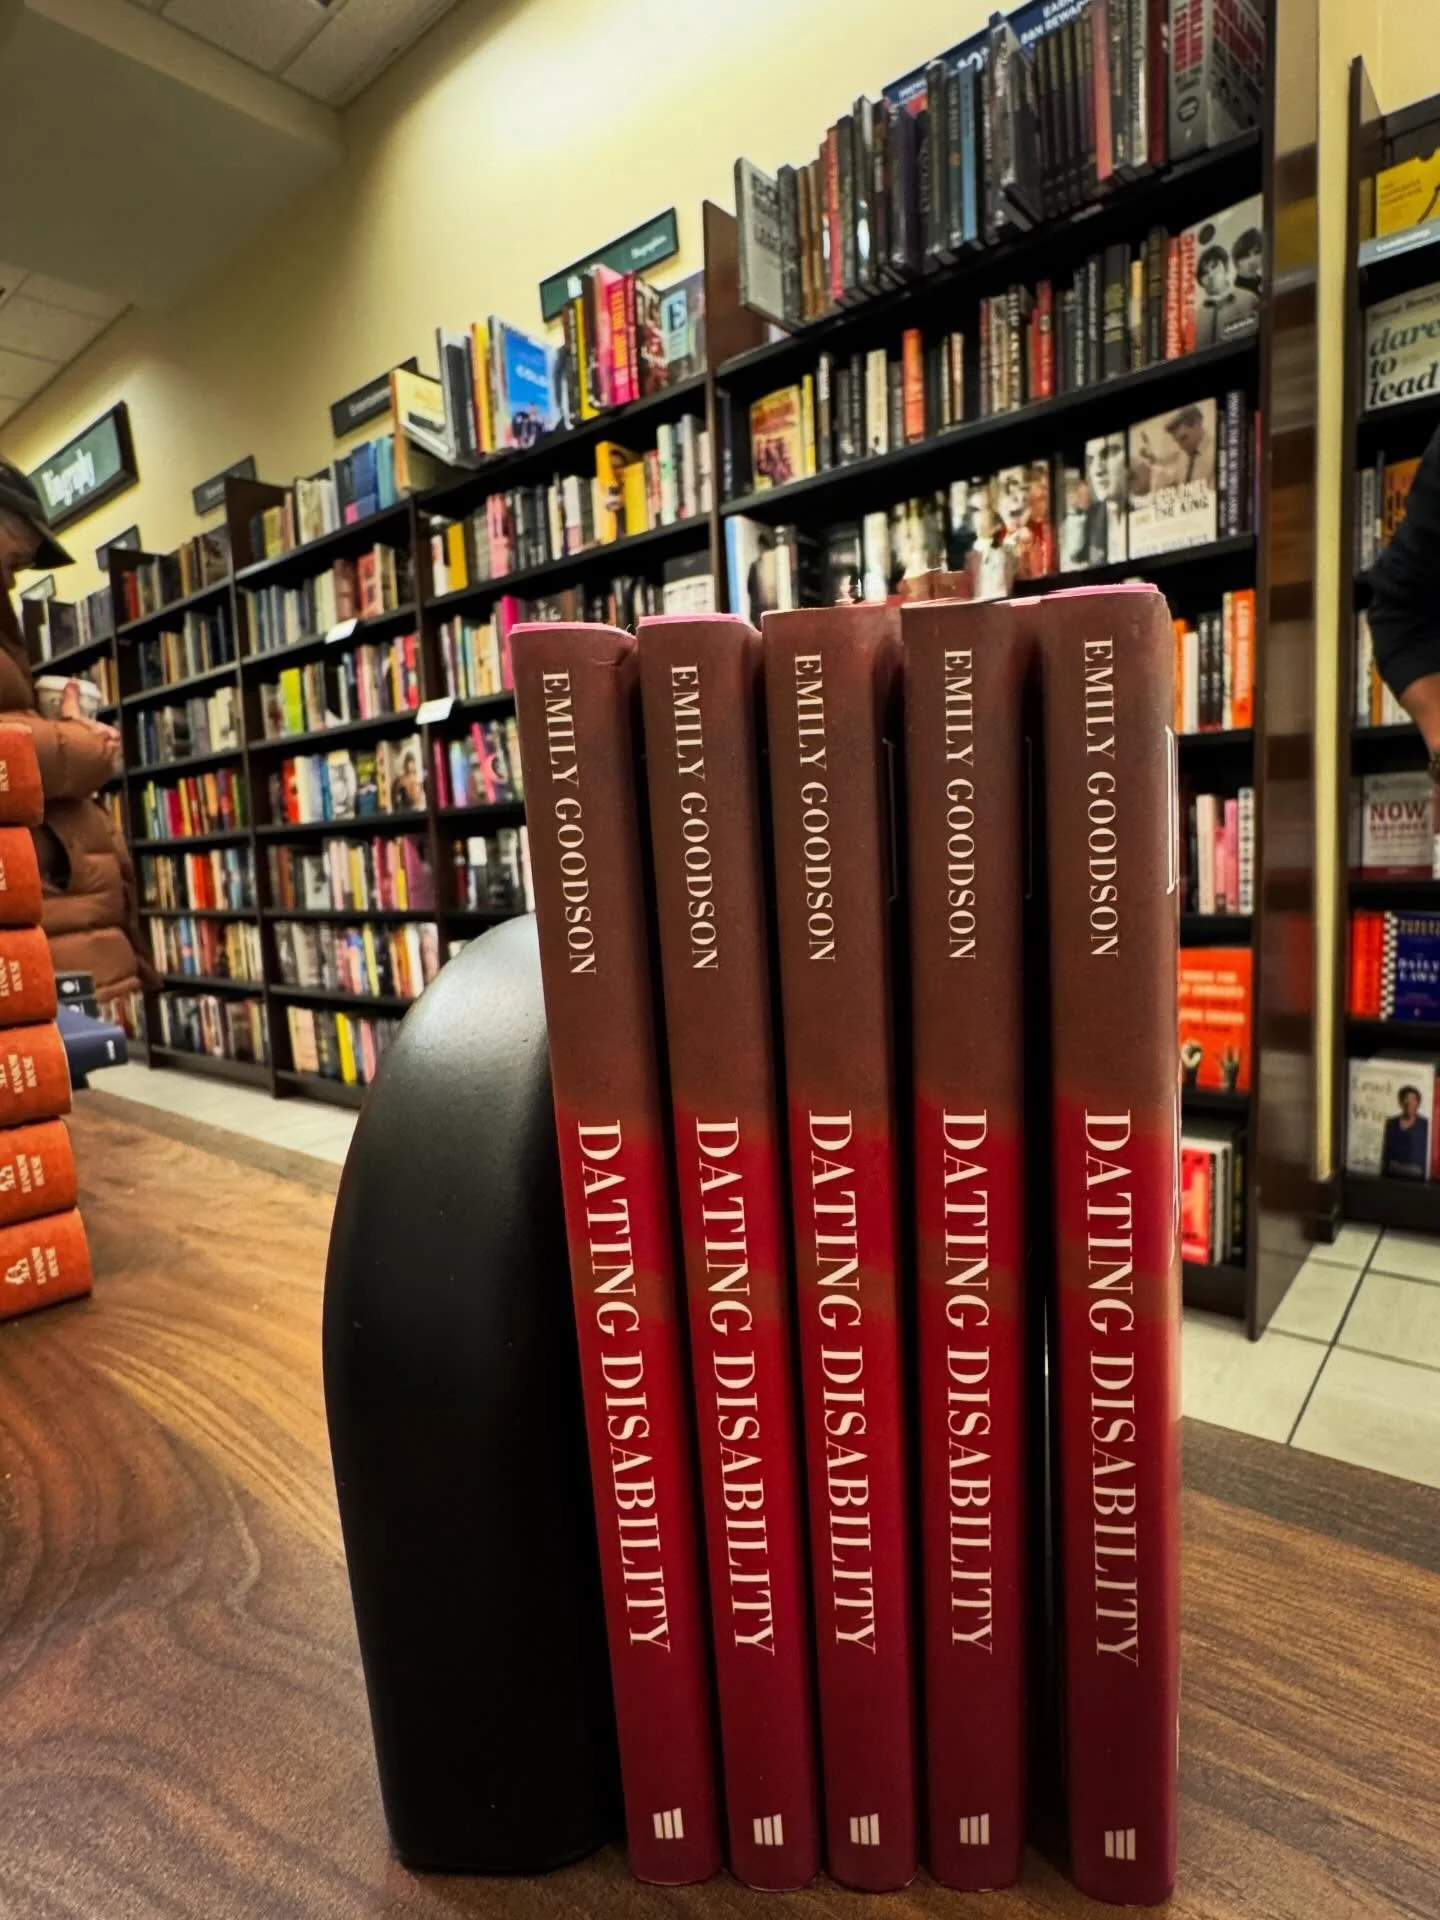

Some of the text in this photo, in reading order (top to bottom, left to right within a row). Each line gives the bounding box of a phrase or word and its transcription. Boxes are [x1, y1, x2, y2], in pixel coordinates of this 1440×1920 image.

[1369, 318, 1440, 357] dare
[1370, 361, 1438, 406] lead
[1371, 357, 1397, 378] to
[543, 671, 597, 974] EMILY GOODSON
[667, 665, 718, 968] EMILY GOODSON
[795, 654, 836, 960] EMILY GOODSON
[944, 650, 976, 960] EMILY GOODSON
[1084, 639, 1118, 957] EMILY GOODSON
[1371, 799, 1426, 821] NOW
[577, 1119, 671, 1652] DATING DISABILITY
[696, 1116, 774, 1655] DATING DISABILITY
[809, 1110, 876, 1653] DATING DISABILITY
[943, 1109, 992, 1653] DATING DISABILITY
[1085, 1109, 1138, 1665] DATING DISABILITY
